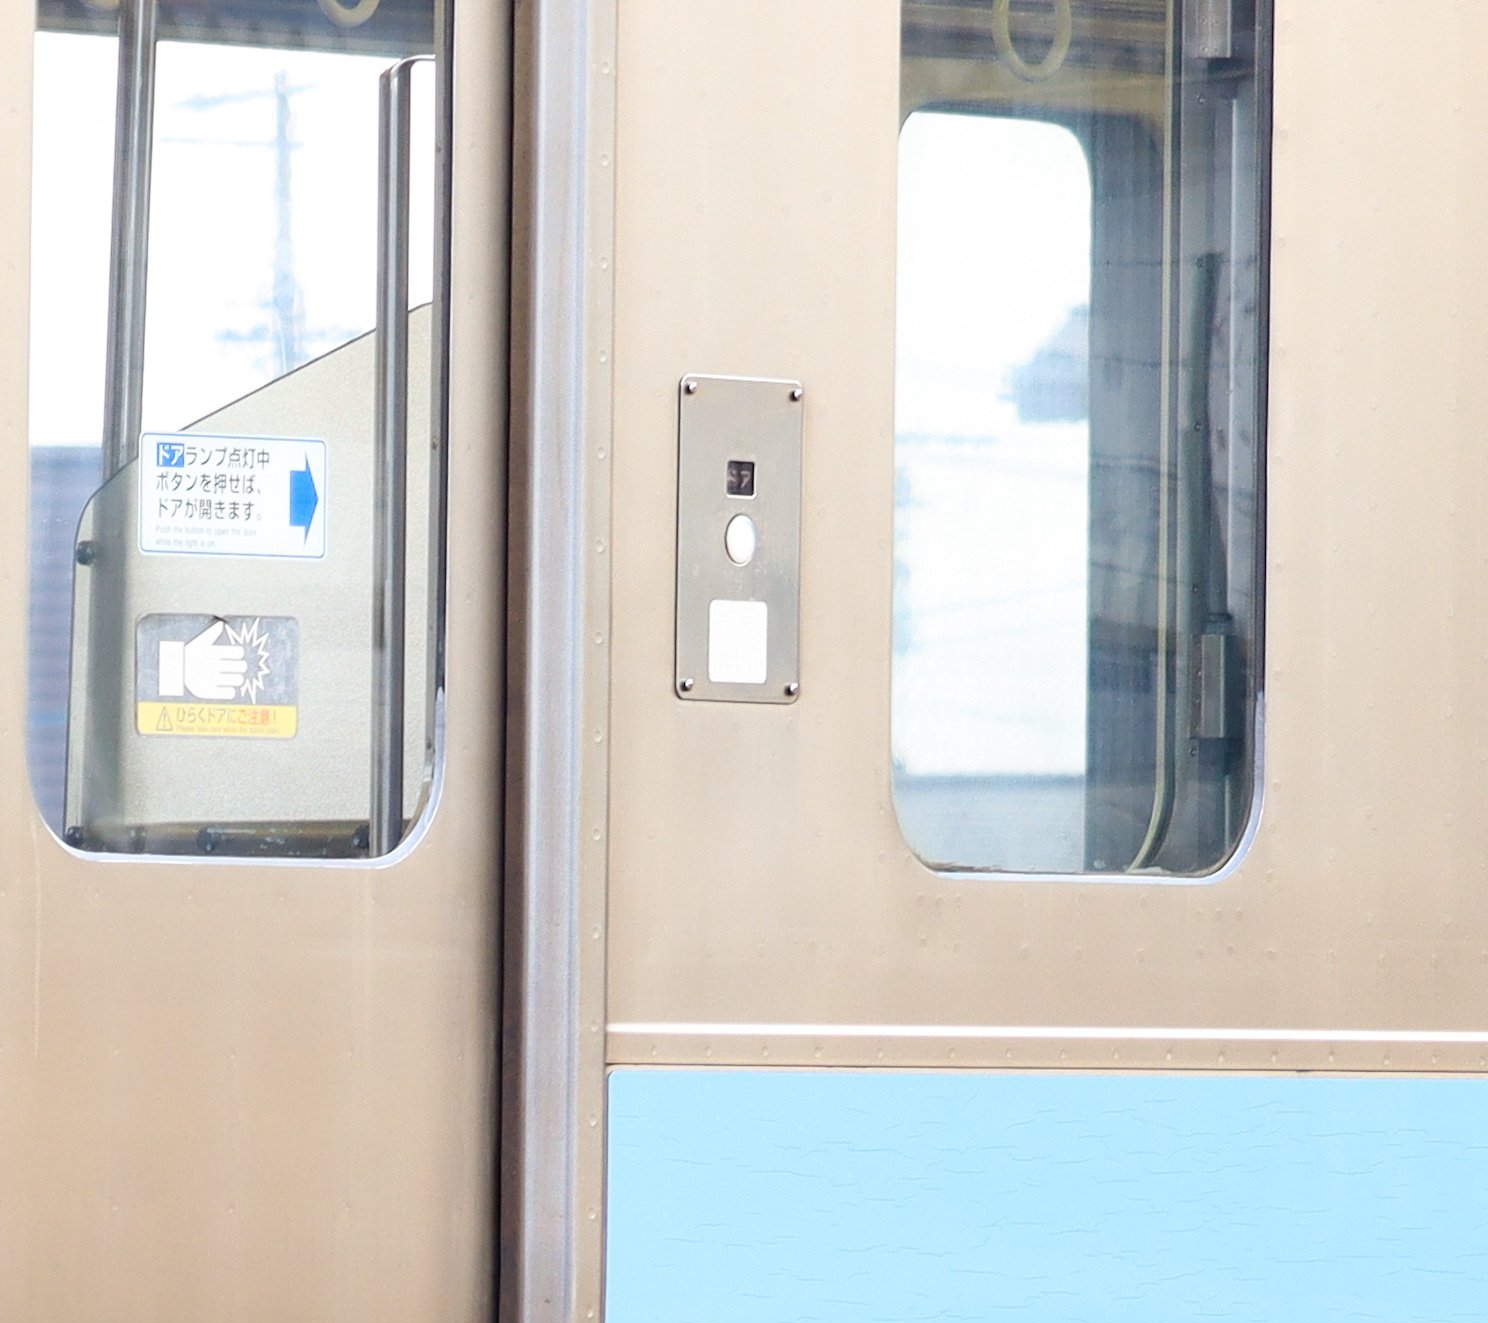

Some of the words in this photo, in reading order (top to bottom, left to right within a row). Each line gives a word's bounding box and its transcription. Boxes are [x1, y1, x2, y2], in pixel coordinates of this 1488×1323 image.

[157, 443, 270, 470] ドアランプ点灯中
[156, 471, 262, 495] ボタンを押せば、
[158, 497, 262, 521] ドアが開きます。
